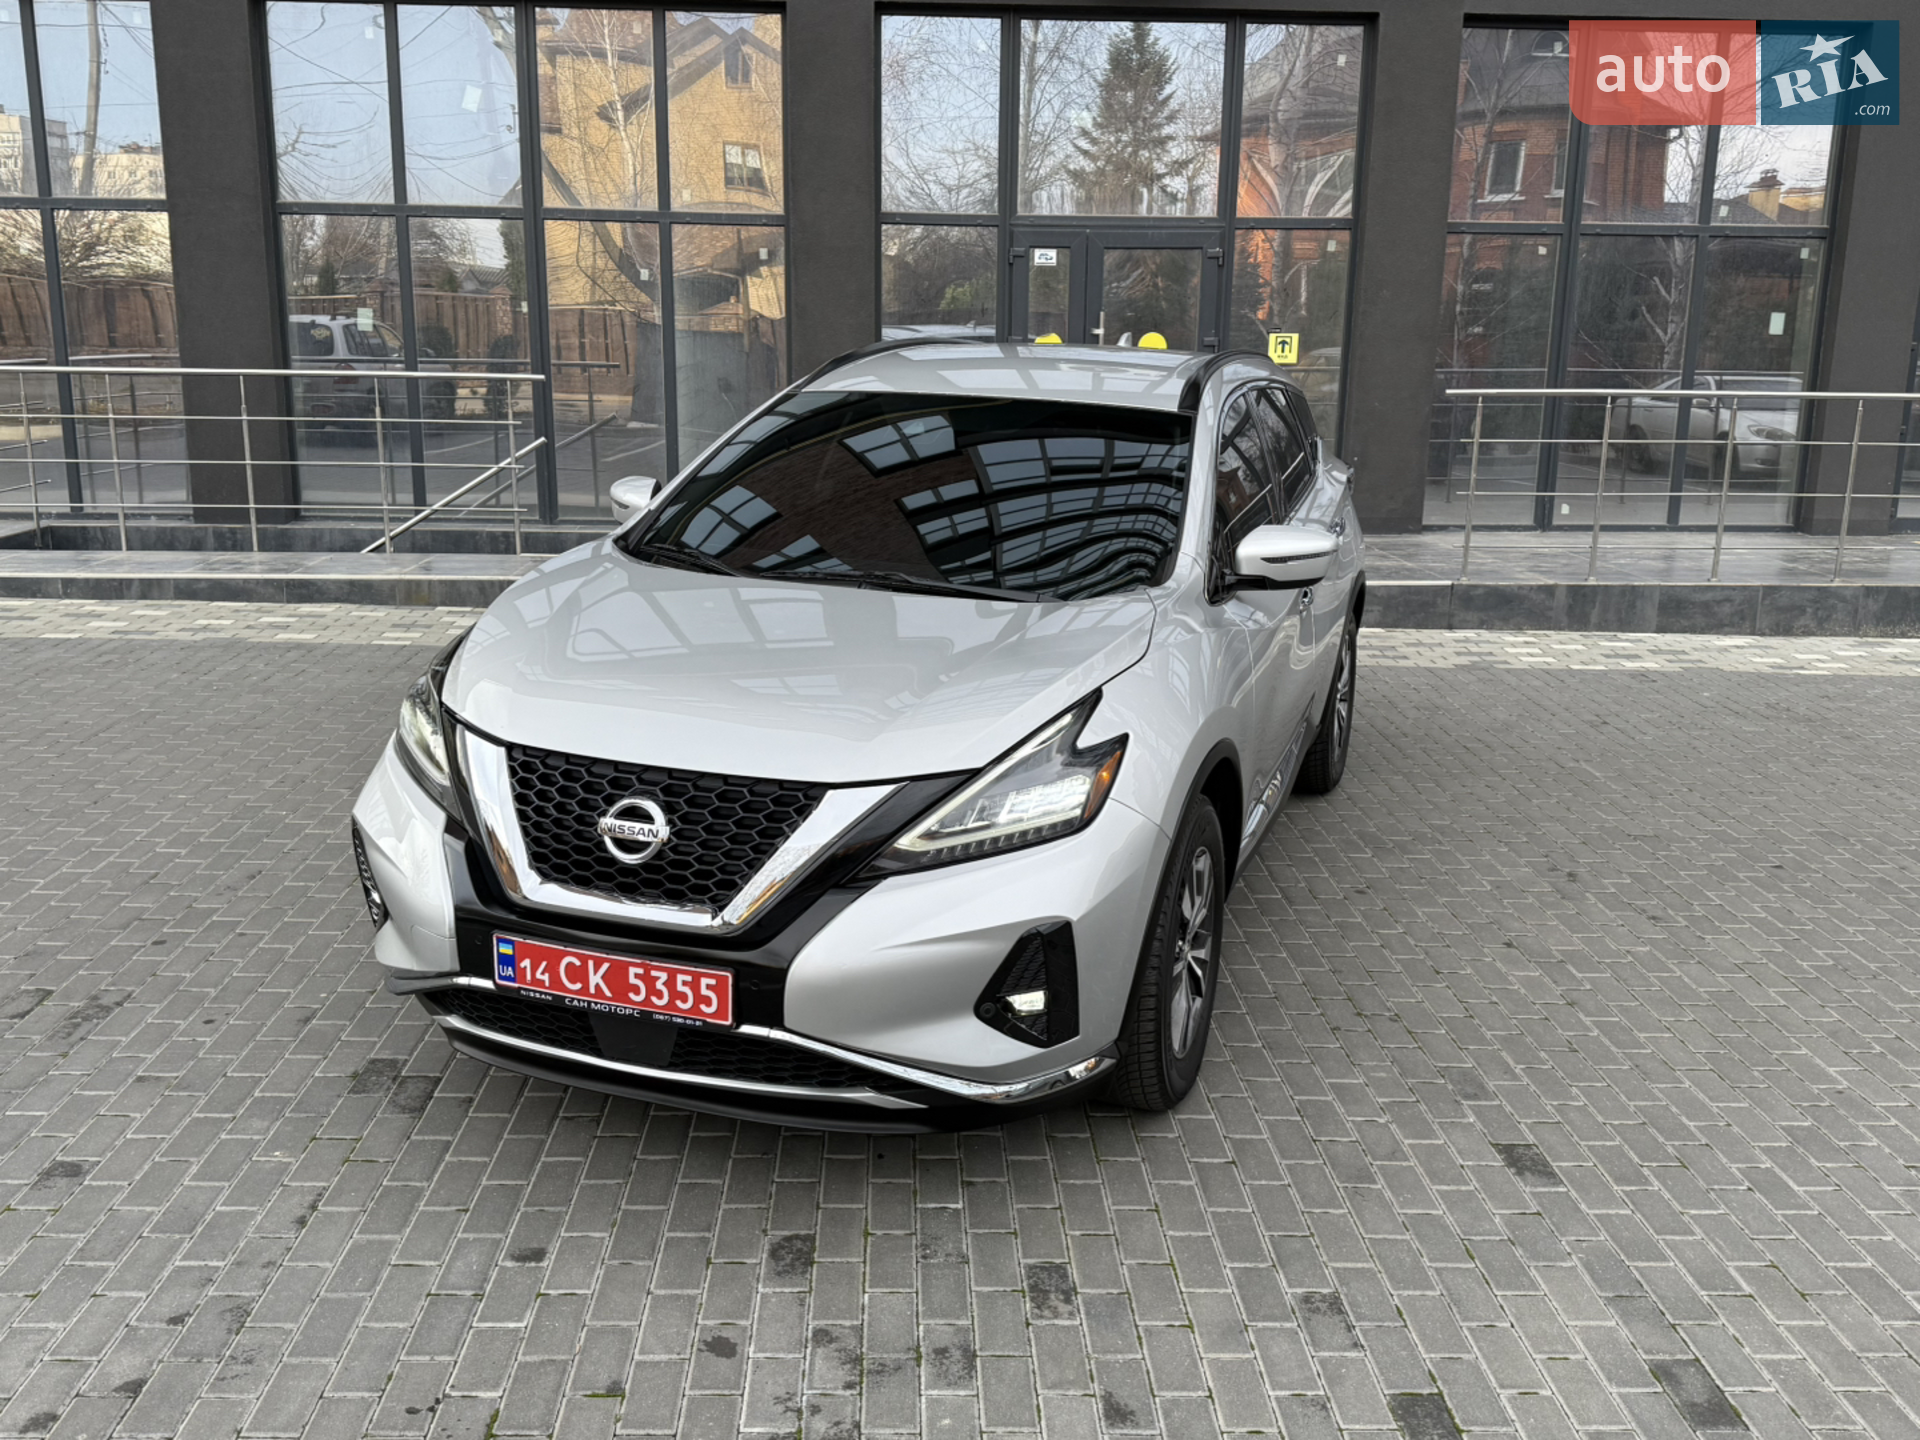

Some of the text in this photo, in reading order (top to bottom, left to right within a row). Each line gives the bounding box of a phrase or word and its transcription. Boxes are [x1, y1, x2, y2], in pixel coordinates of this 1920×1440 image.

[602, 822, 660, 839] NISSAN
[499, 964, 515, 978] UA
[519, 955, 719, 1014] 14 CK 5355
[520, 989, 553, 1000] NISSAN
[564, 998, 641, 1017] САН МОТОРС
